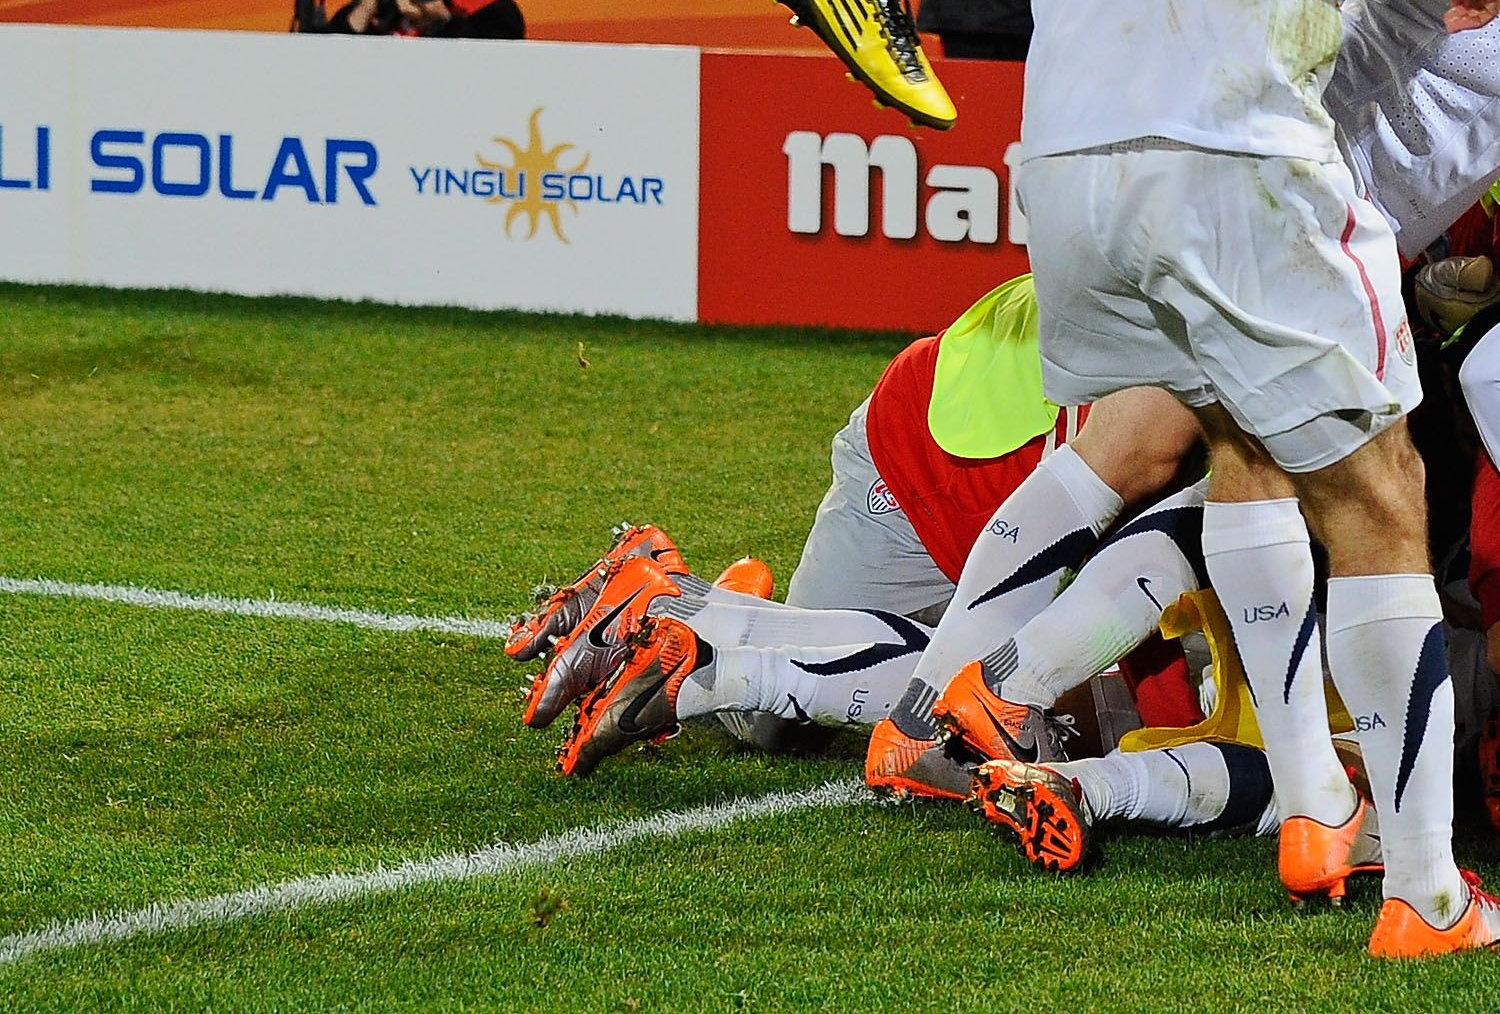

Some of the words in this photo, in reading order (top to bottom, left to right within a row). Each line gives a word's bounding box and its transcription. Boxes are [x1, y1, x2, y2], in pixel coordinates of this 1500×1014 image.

[91, 130, 378, 206] SOLAR
[410, 167, 525, 199] YINGLI
[541, 173, 664, 205] SOLAR
[1243, 602, 1290, 624] USA
